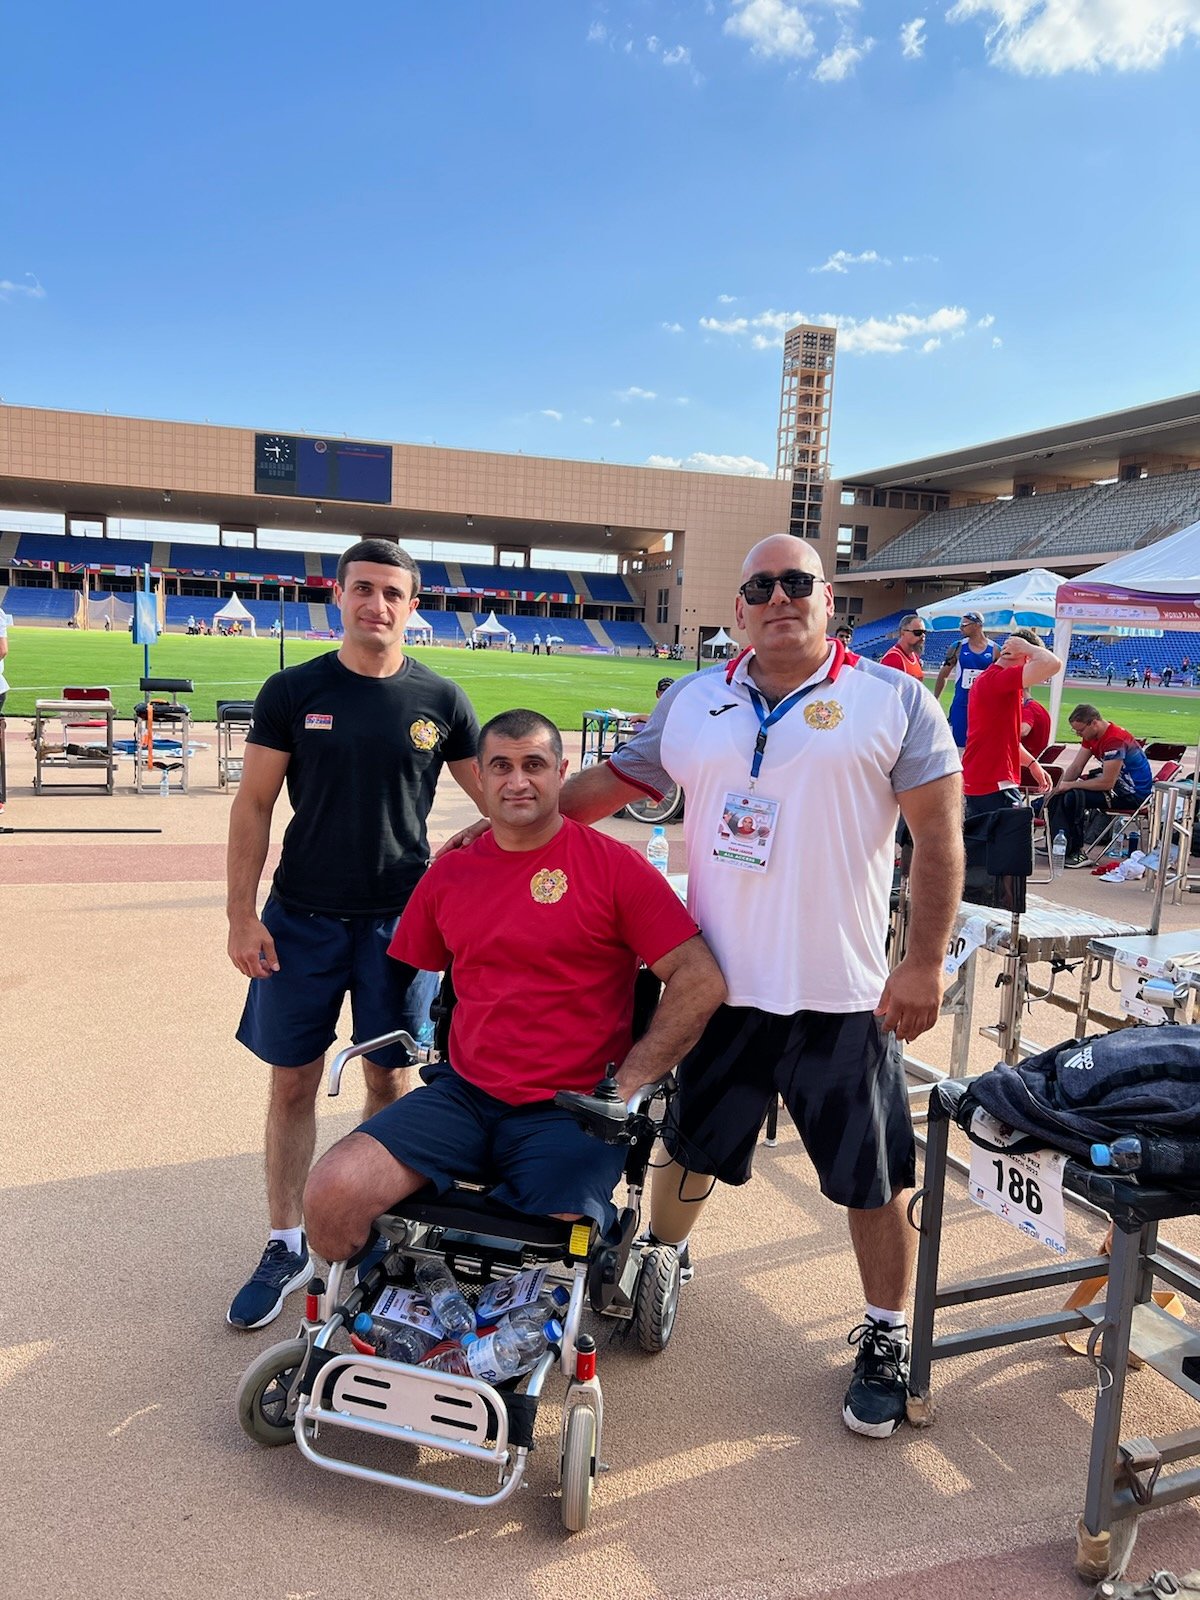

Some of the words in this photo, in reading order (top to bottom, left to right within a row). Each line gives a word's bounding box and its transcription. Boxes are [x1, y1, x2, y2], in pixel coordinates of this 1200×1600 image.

[1182, 611, 1199, 619] PARA
[735, 853, 756, 862] ACCESS
[992, 1159, 1043, 1215] 186
[1045, 1237, 1068, 1255] alsa
